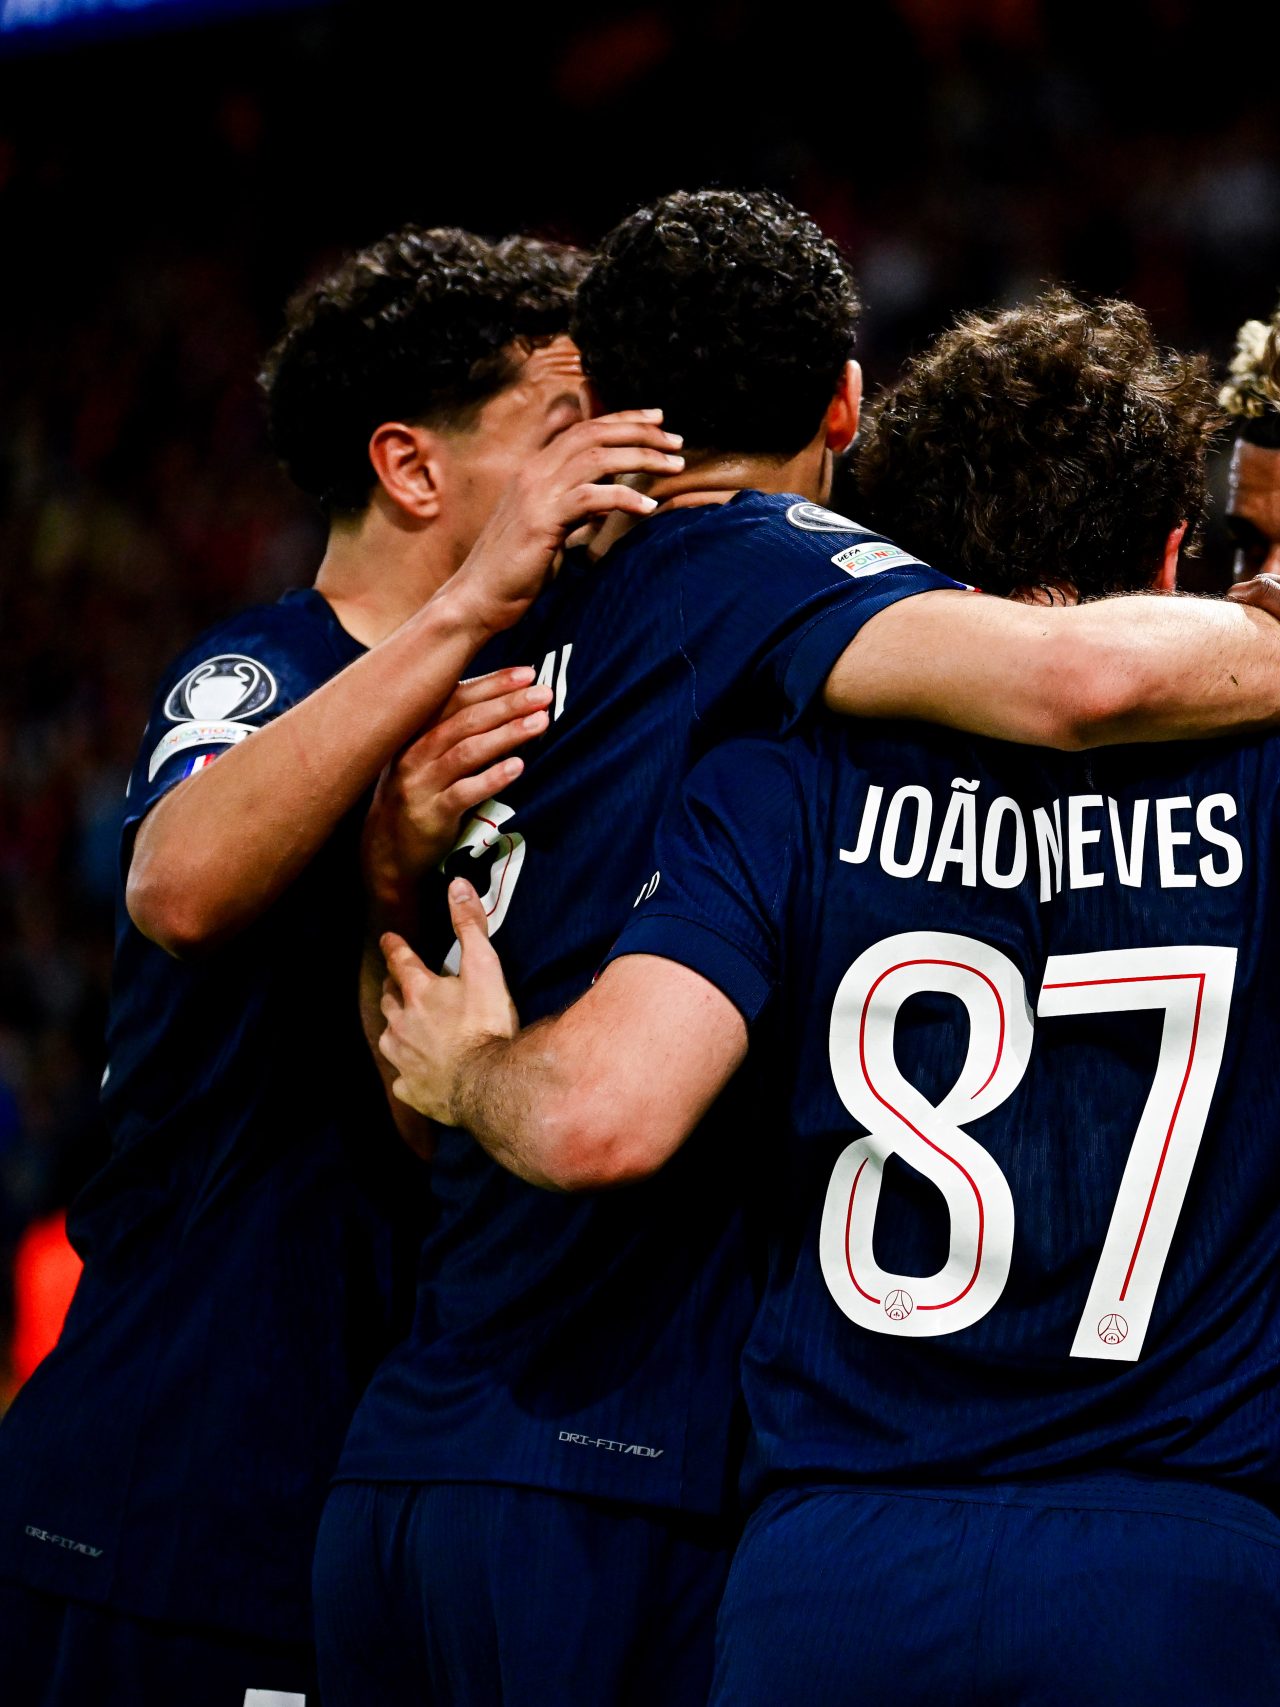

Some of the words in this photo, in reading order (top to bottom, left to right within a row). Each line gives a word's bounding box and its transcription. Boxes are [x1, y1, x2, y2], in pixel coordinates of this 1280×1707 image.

[837, 548, 861, 563] UEFA
[839, 777, 1028, 889] JOÃO
[1033, 792, 1244, 903] NEVES
[819, 930, 1239, 1362] 87
